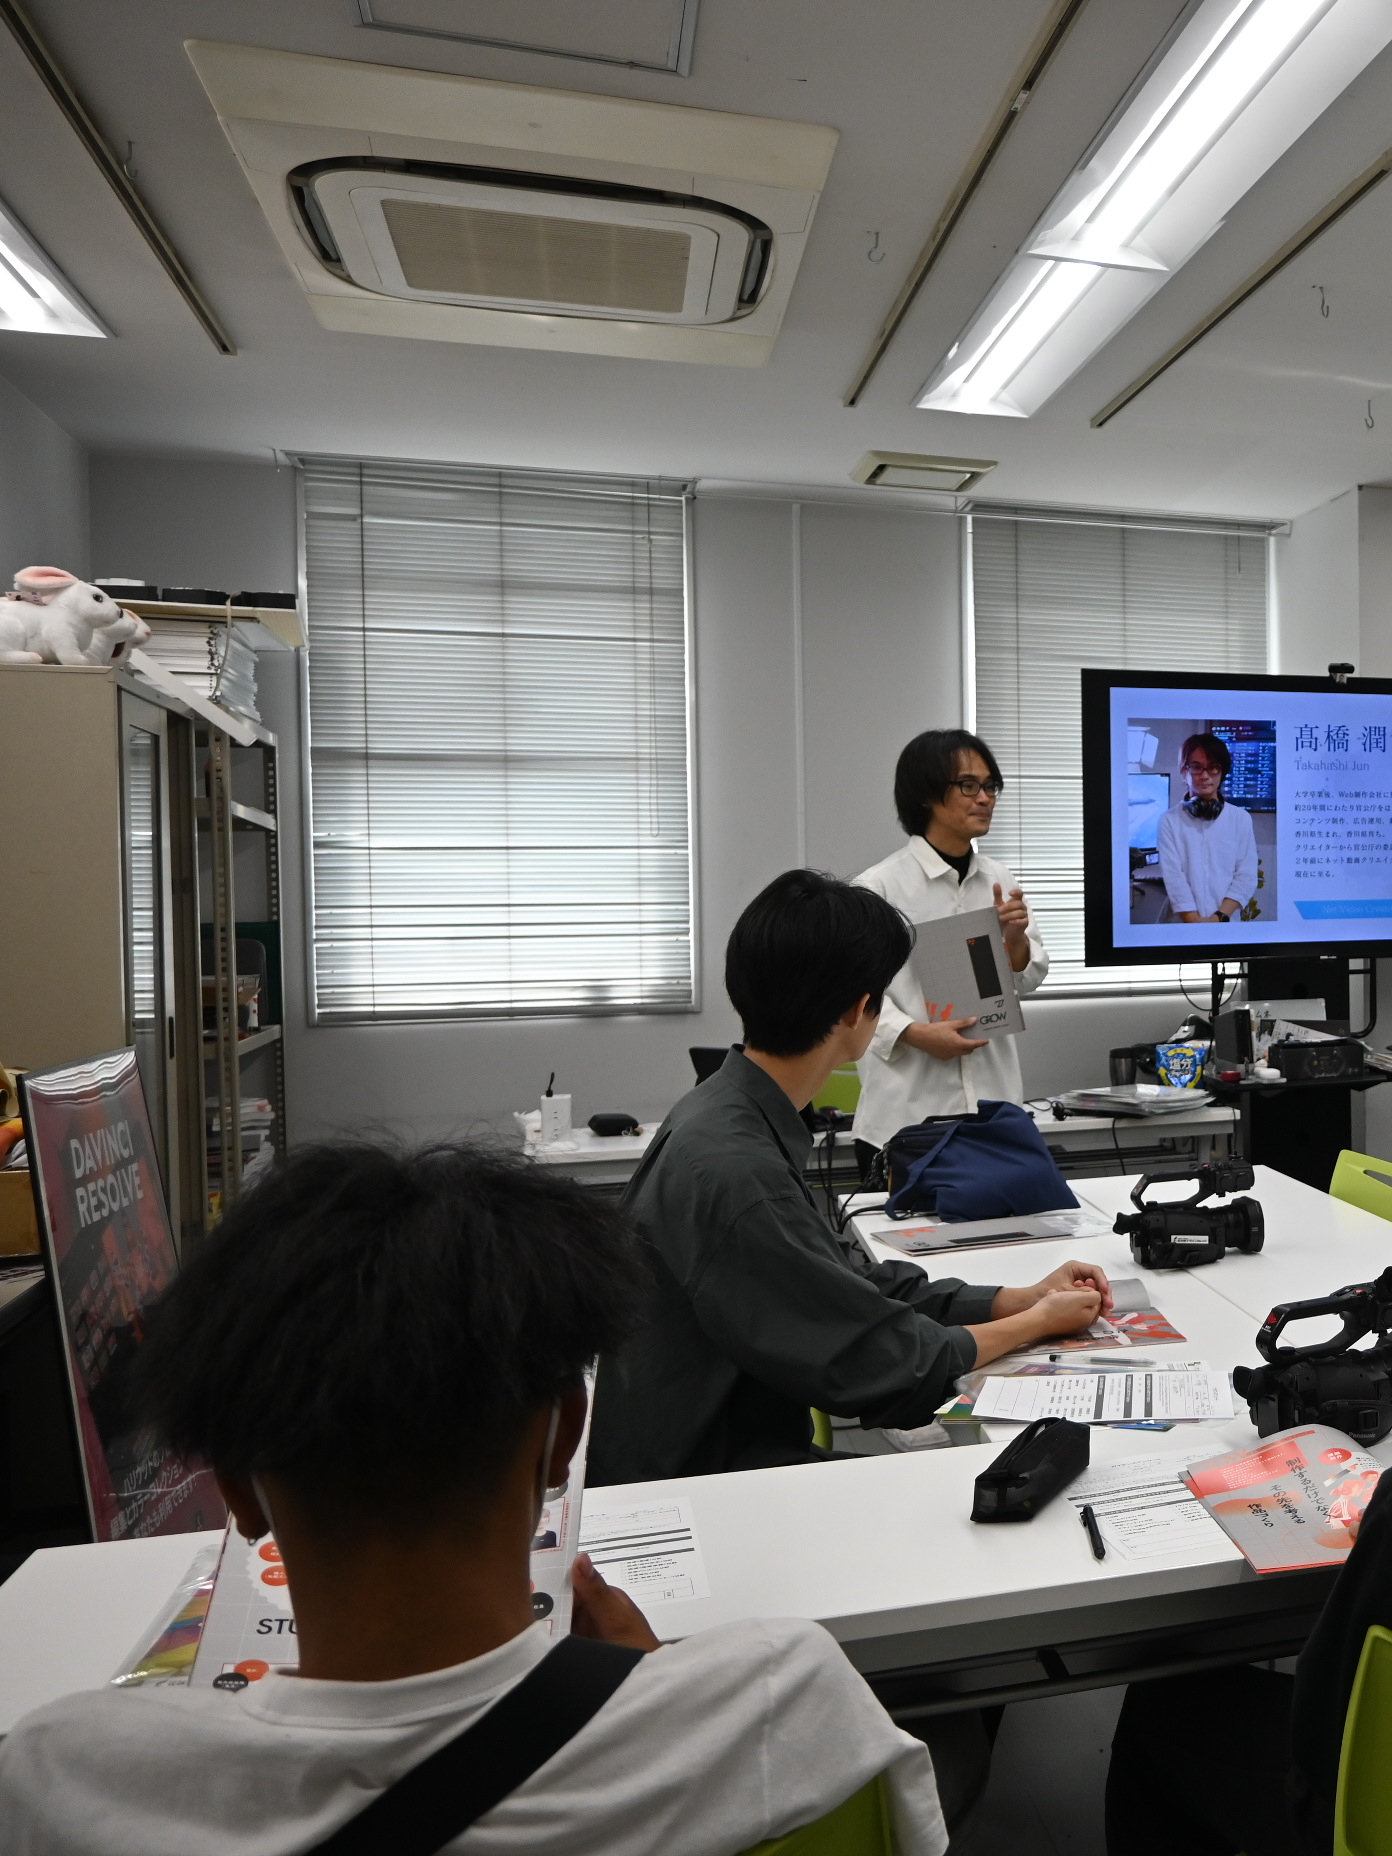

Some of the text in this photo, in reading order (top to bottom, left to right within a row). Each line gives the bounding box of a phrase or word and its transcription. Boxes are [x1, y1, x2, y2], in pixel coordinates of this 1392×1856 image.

[1361, 725, 1387, 753] 潤
[1294, 760, 1370, 772] Takahashi Jun
[979, 1011, 1007, 1025] GROW
[1169, 1058, 1192, 1070] 塩分
[69, 1119, 134, 1179] DAVINCI
[75, 1161, 144, 1228] RESOLVE
[1349, 1431, 1377, 1439] Panasonic
